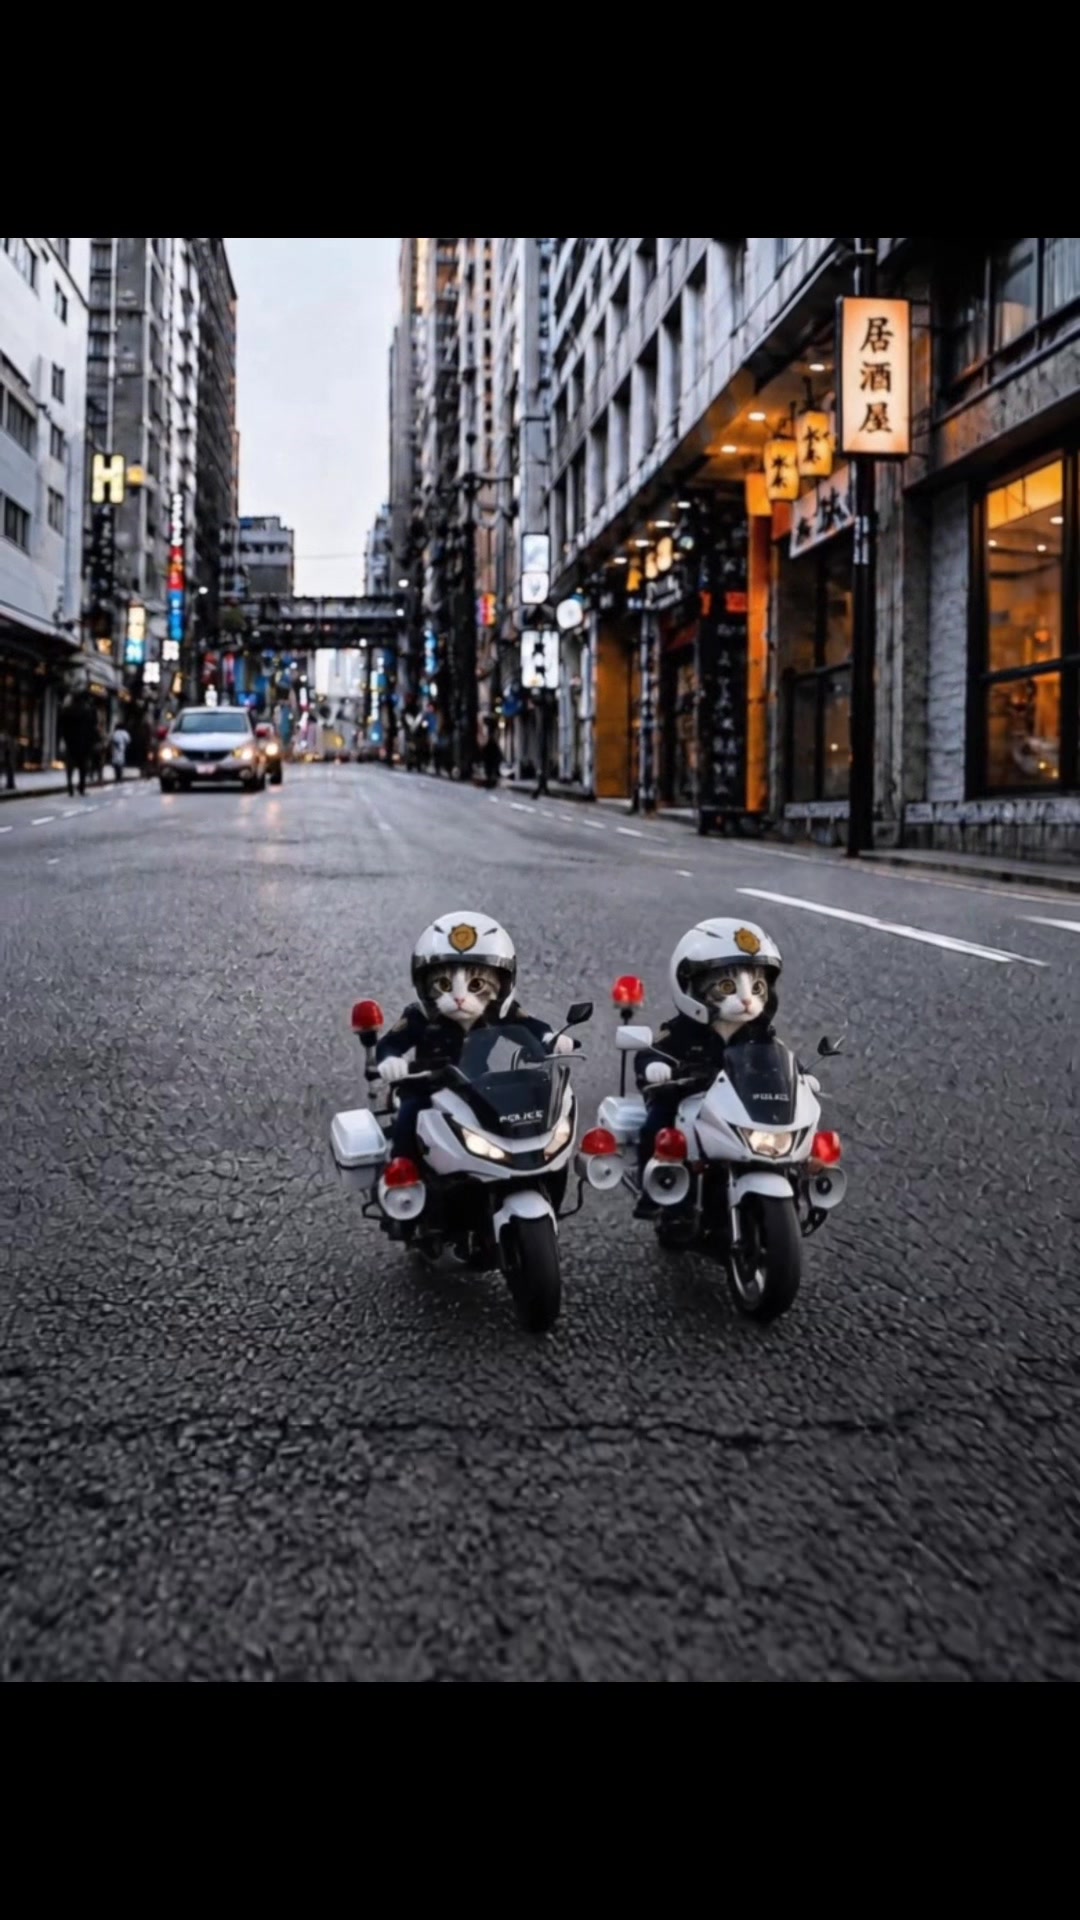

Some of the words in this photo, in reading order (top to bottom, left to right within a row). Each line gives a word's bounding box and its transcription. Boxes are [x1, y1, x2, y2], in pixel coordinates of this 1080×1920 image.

[858, 316, 895, 434] 居酒屋
[91, 454, 125, 503] H
